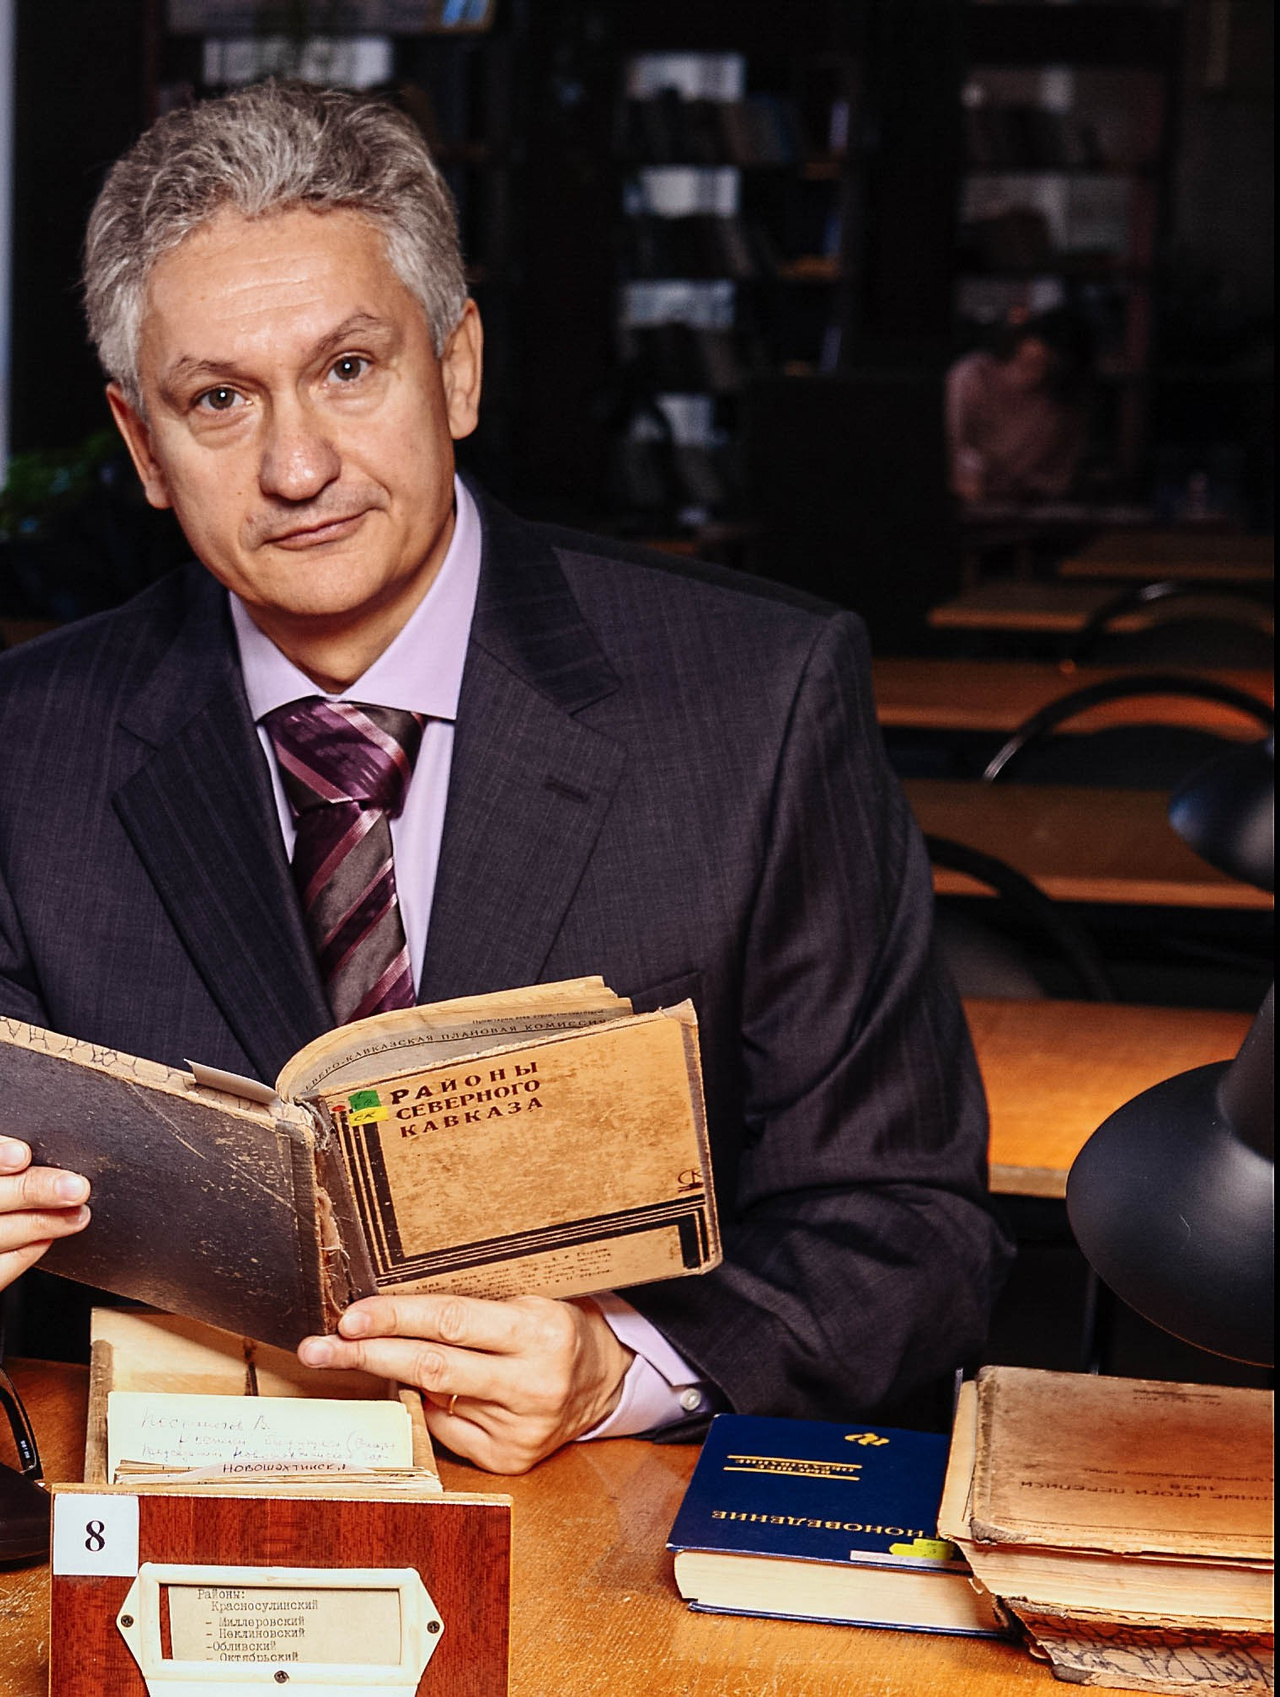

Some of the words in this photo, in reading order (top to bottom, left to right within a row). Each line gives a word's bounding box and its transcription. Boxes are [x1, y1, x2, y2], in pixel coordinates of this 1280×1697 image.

[304, 1035, 433, 1091] ЕВЕРО-КАВКАЗСКАЯ
[440, 1026, 517, 1040] ПЛАНОВАЯ
[389, 1061, 538, 1105] РАЙОНЫ
[396, 1079, 540, 1120] СЕВЕРНОГО
[400, 1097, 543, 1138] КАВКАЗА
[1135, 1488, 1201, 1499] ИТОГИ
[711, 1510, 930, 1538] ИОНОВЕДЕНИЕ
[84, 1519, 106, 1552] 8
[197, 1589, 245, 1600] Районы:
[211, 1600, 318, 1613] Красносулинский
[219, 1616, 305, 1629] Миллеровский
[219, 1628, 306, 1639] Неклиновский
[219, 1652, 299, 1662] Октябрьский
